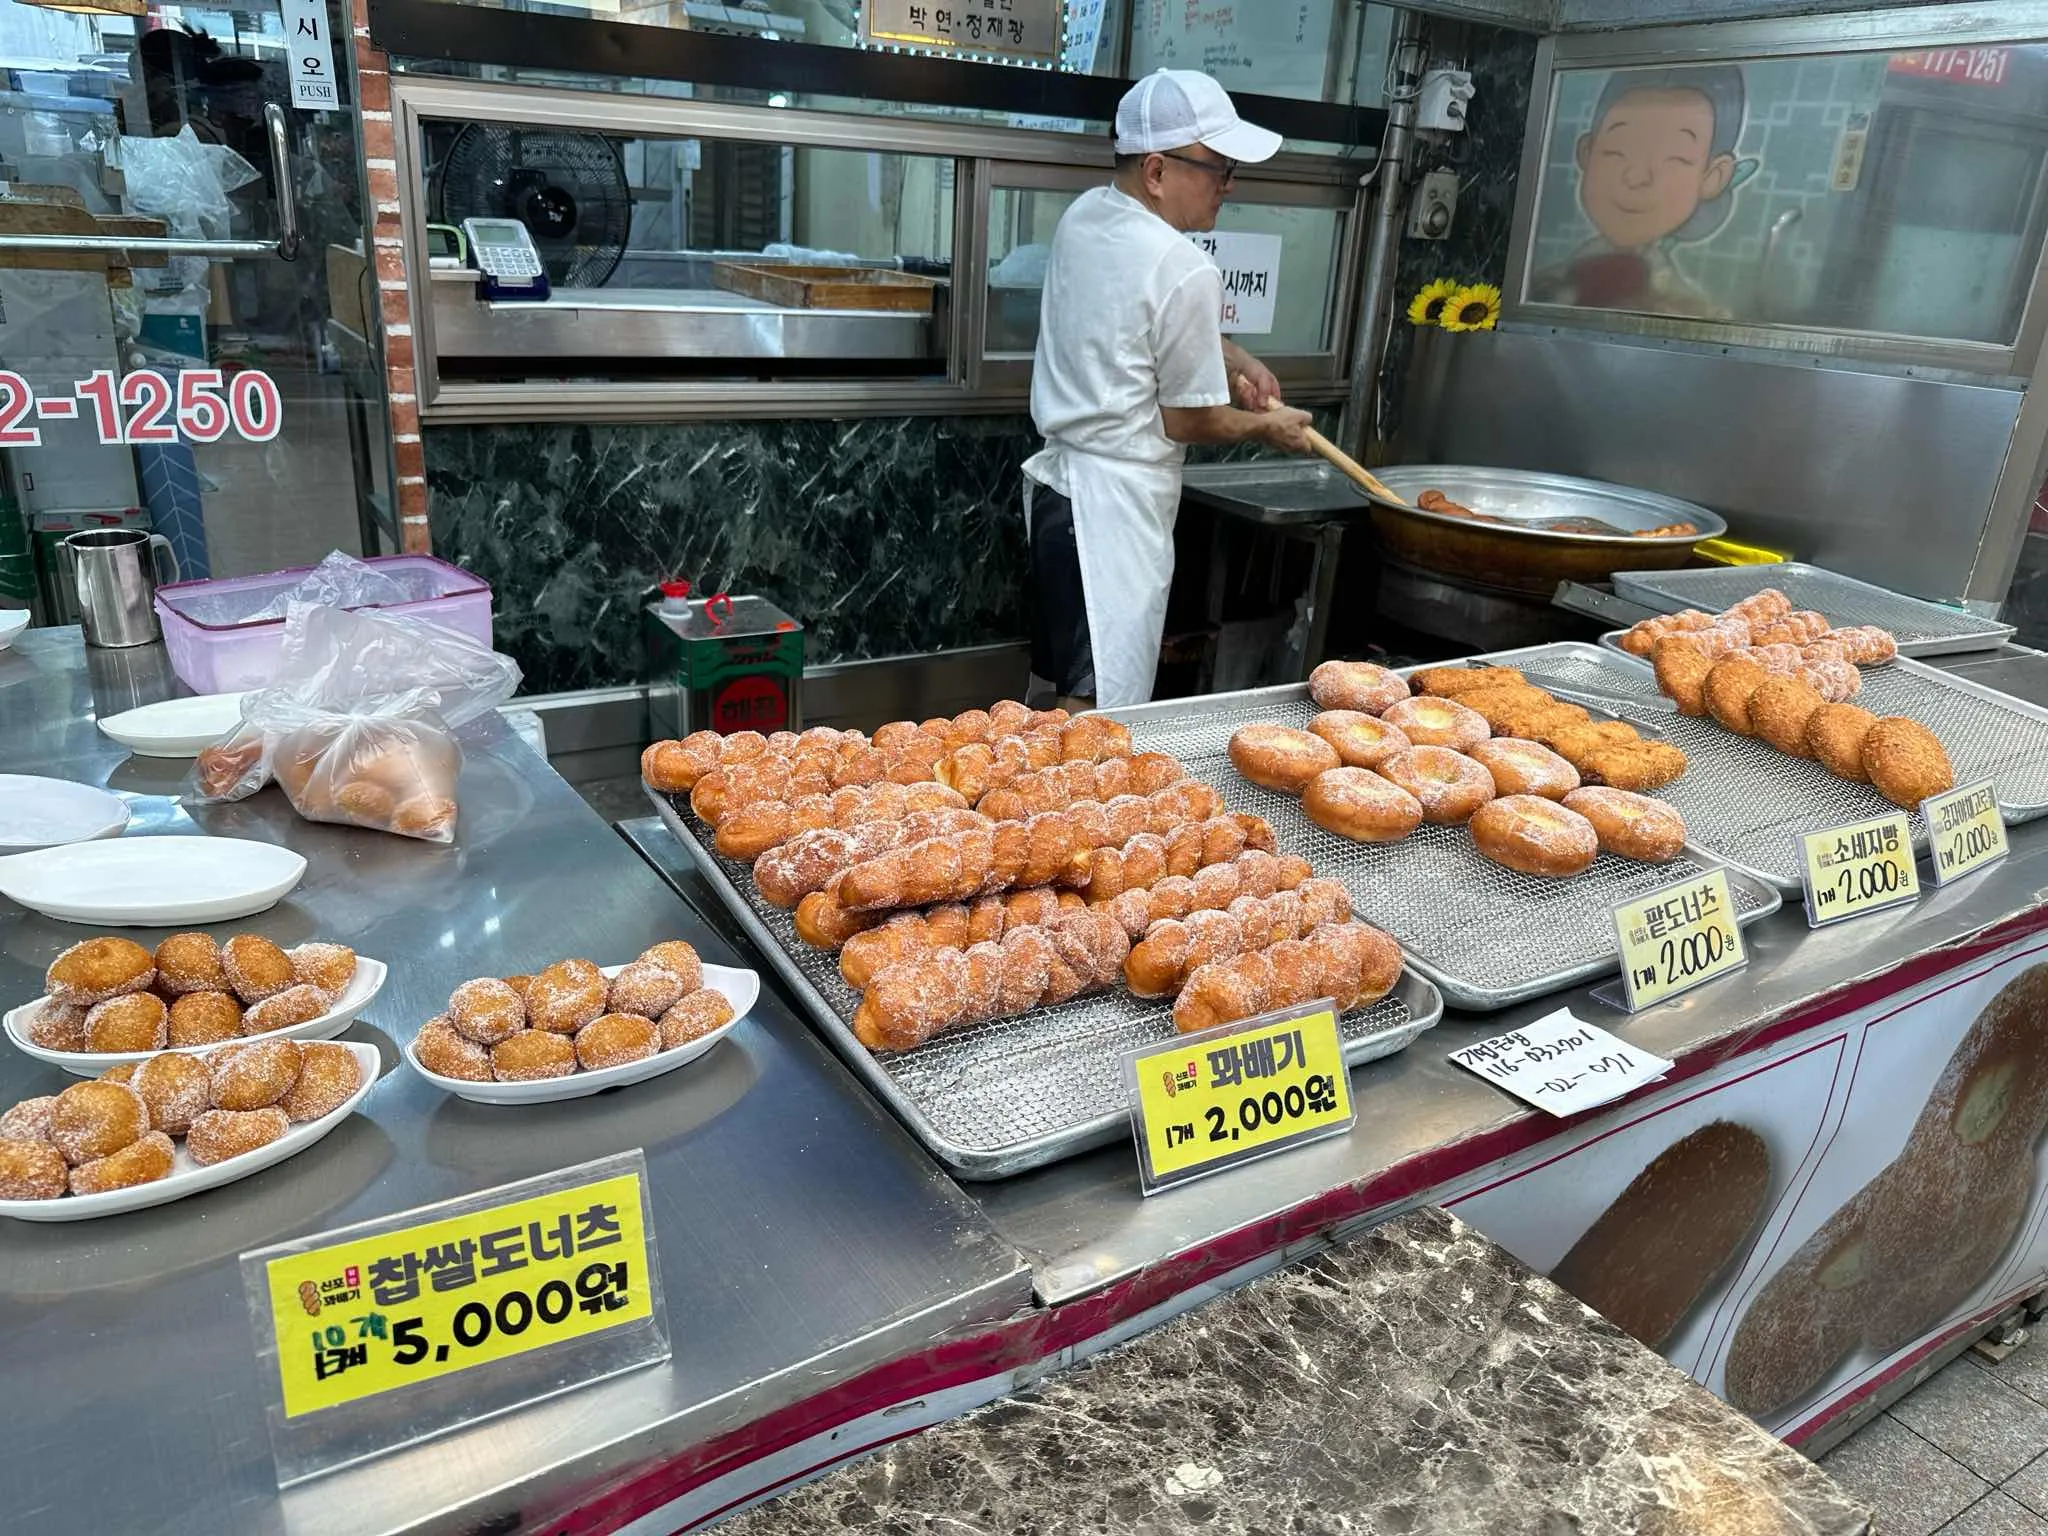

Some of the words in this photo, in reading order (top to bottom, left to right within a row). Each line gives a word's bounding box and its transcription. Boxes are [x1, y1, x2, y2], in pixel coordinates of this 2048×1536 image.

[297, 0, 325, 76] 시오
[300, 86, 332, 98] PUSH
[0, 369, 282, 446] 2-1250
[1834, 824, 1900, 865] 소세지빵
[1644, 885, 1720, 939] 팥도너츠
[1817, 887, 1836, 906] 1개
[1206, 1030, 1306, 1089] 꽈배기
[1165, 1123, 1195, 1148] 1개
[1204, 1074, 1337, 1142] 2,000원
[368, 1204, 622, 1306] 찹쌀도너츠
[392, 1262, 629, 1366] 5,000원
